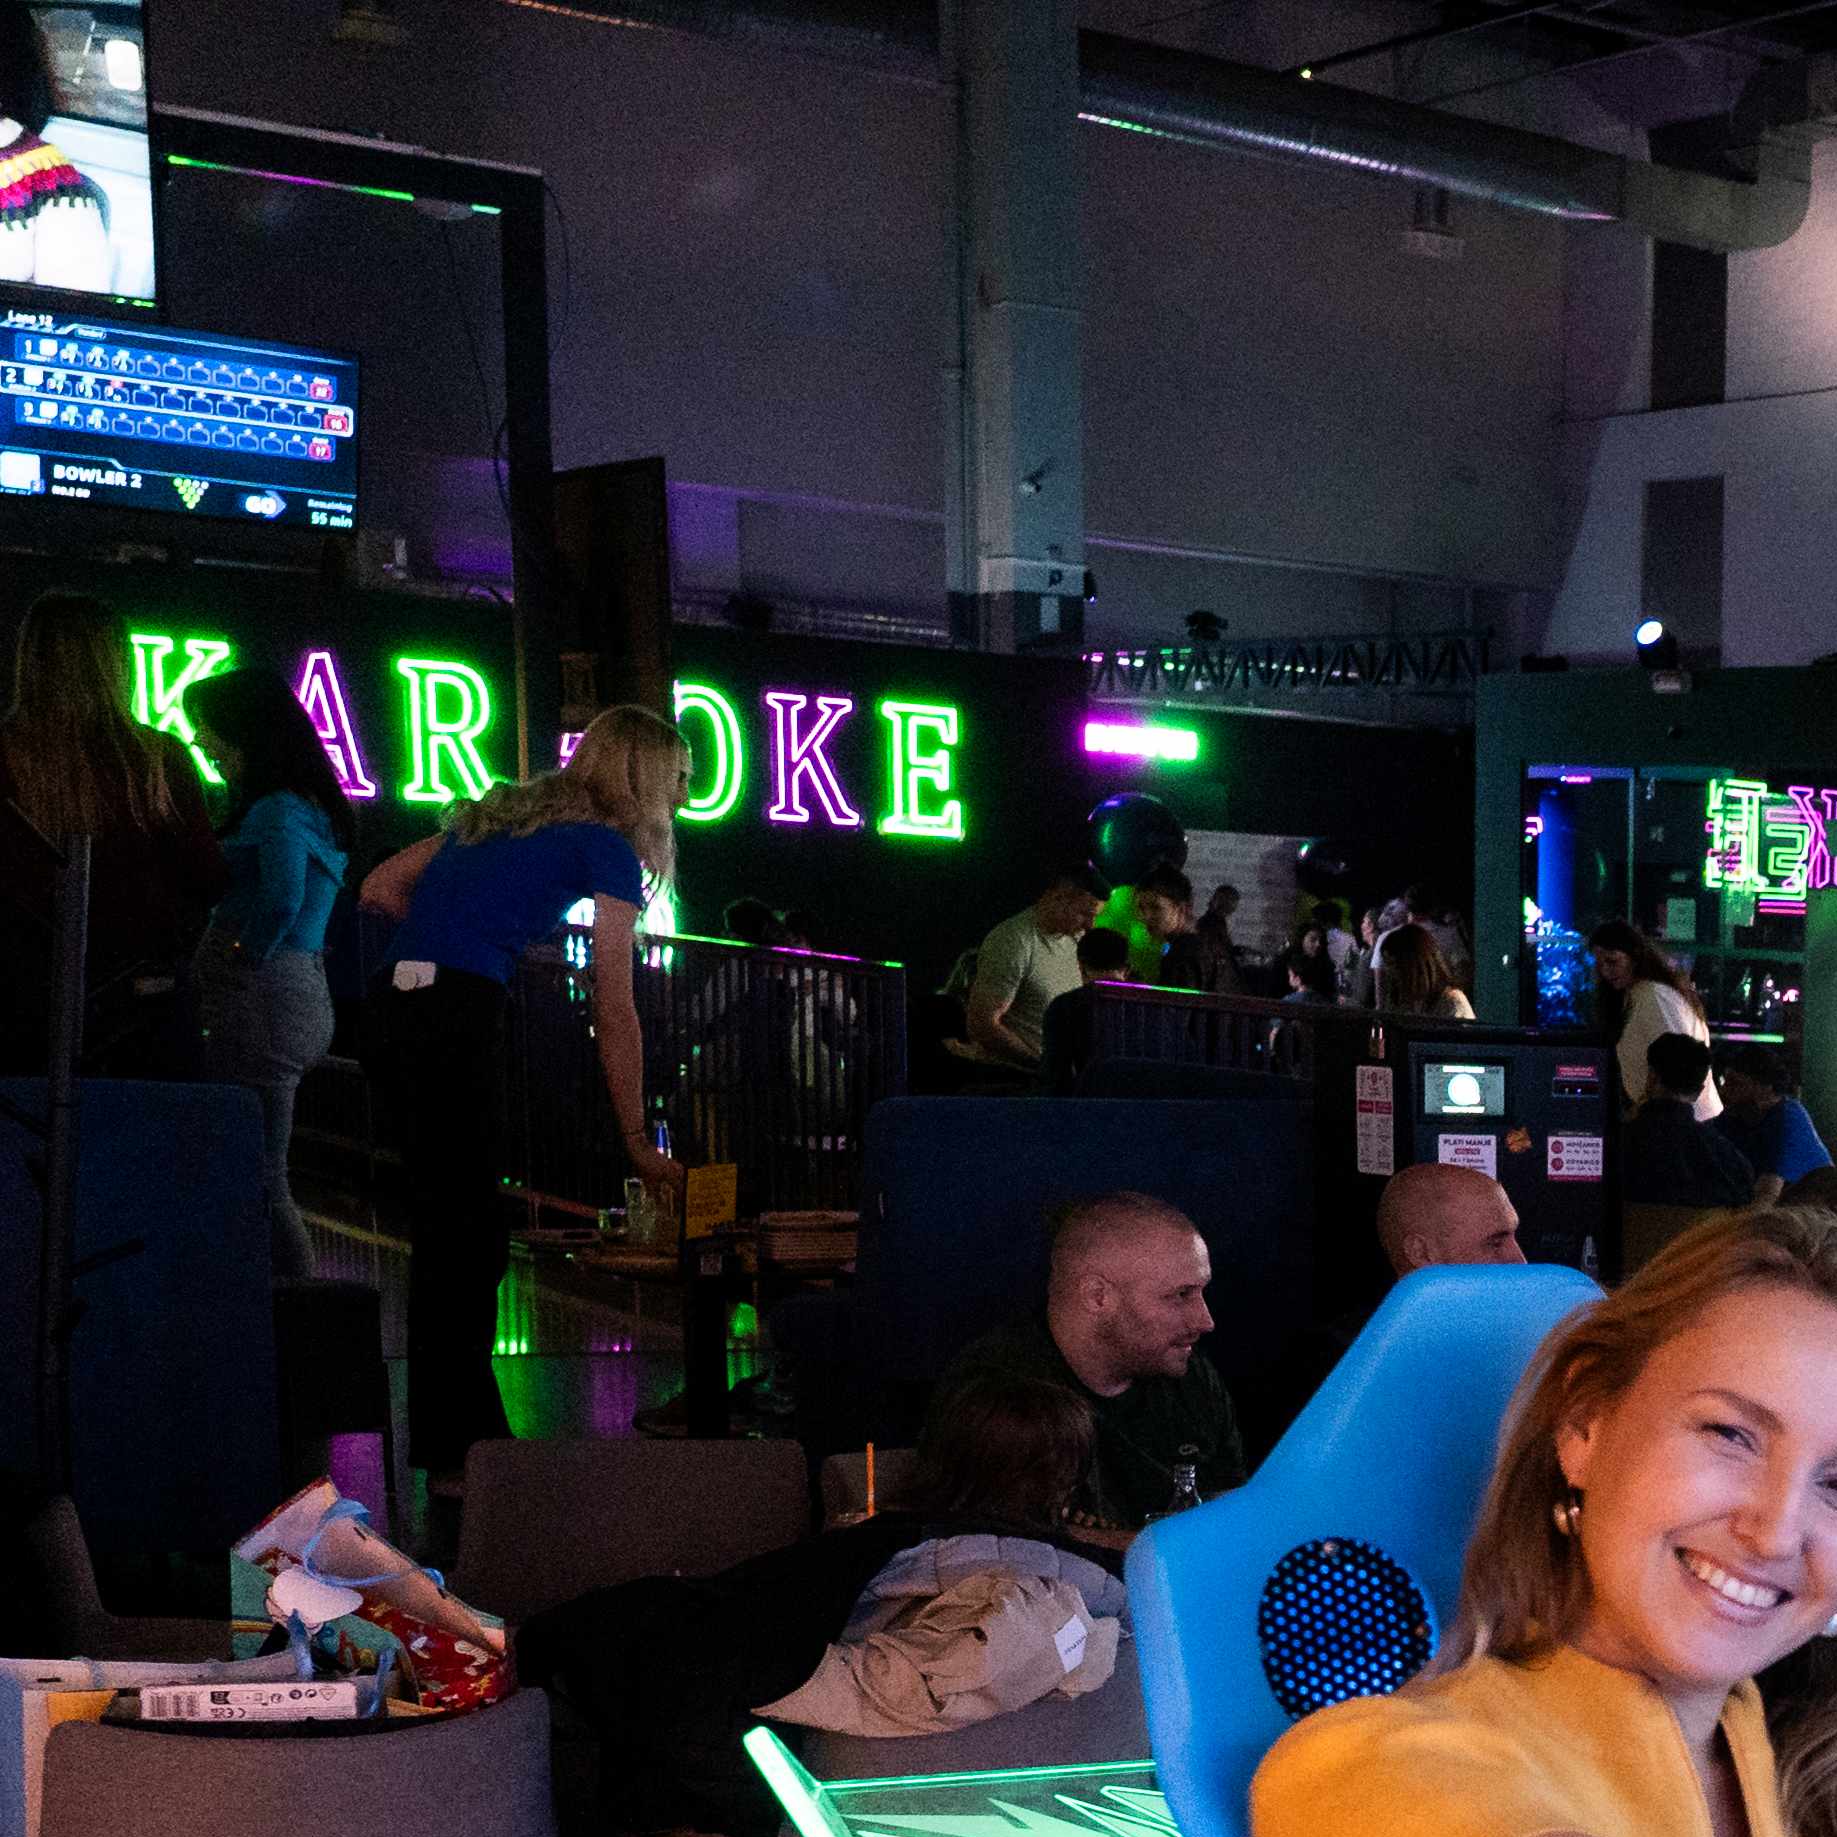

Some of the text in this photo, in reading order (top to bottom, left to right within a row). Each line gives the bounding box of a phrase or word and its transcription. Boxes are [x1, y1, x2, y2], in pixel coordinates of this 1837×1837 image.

[6, 368, 16, 383] 2
[53, 464, 142, 489] BOWLER 2
[246, 495, 277, 515] GO
[308, 499, 353, 513] Remaining
[311, 511, 353, 528] 55 min
[130, 632, 966, 842] KAROKE
